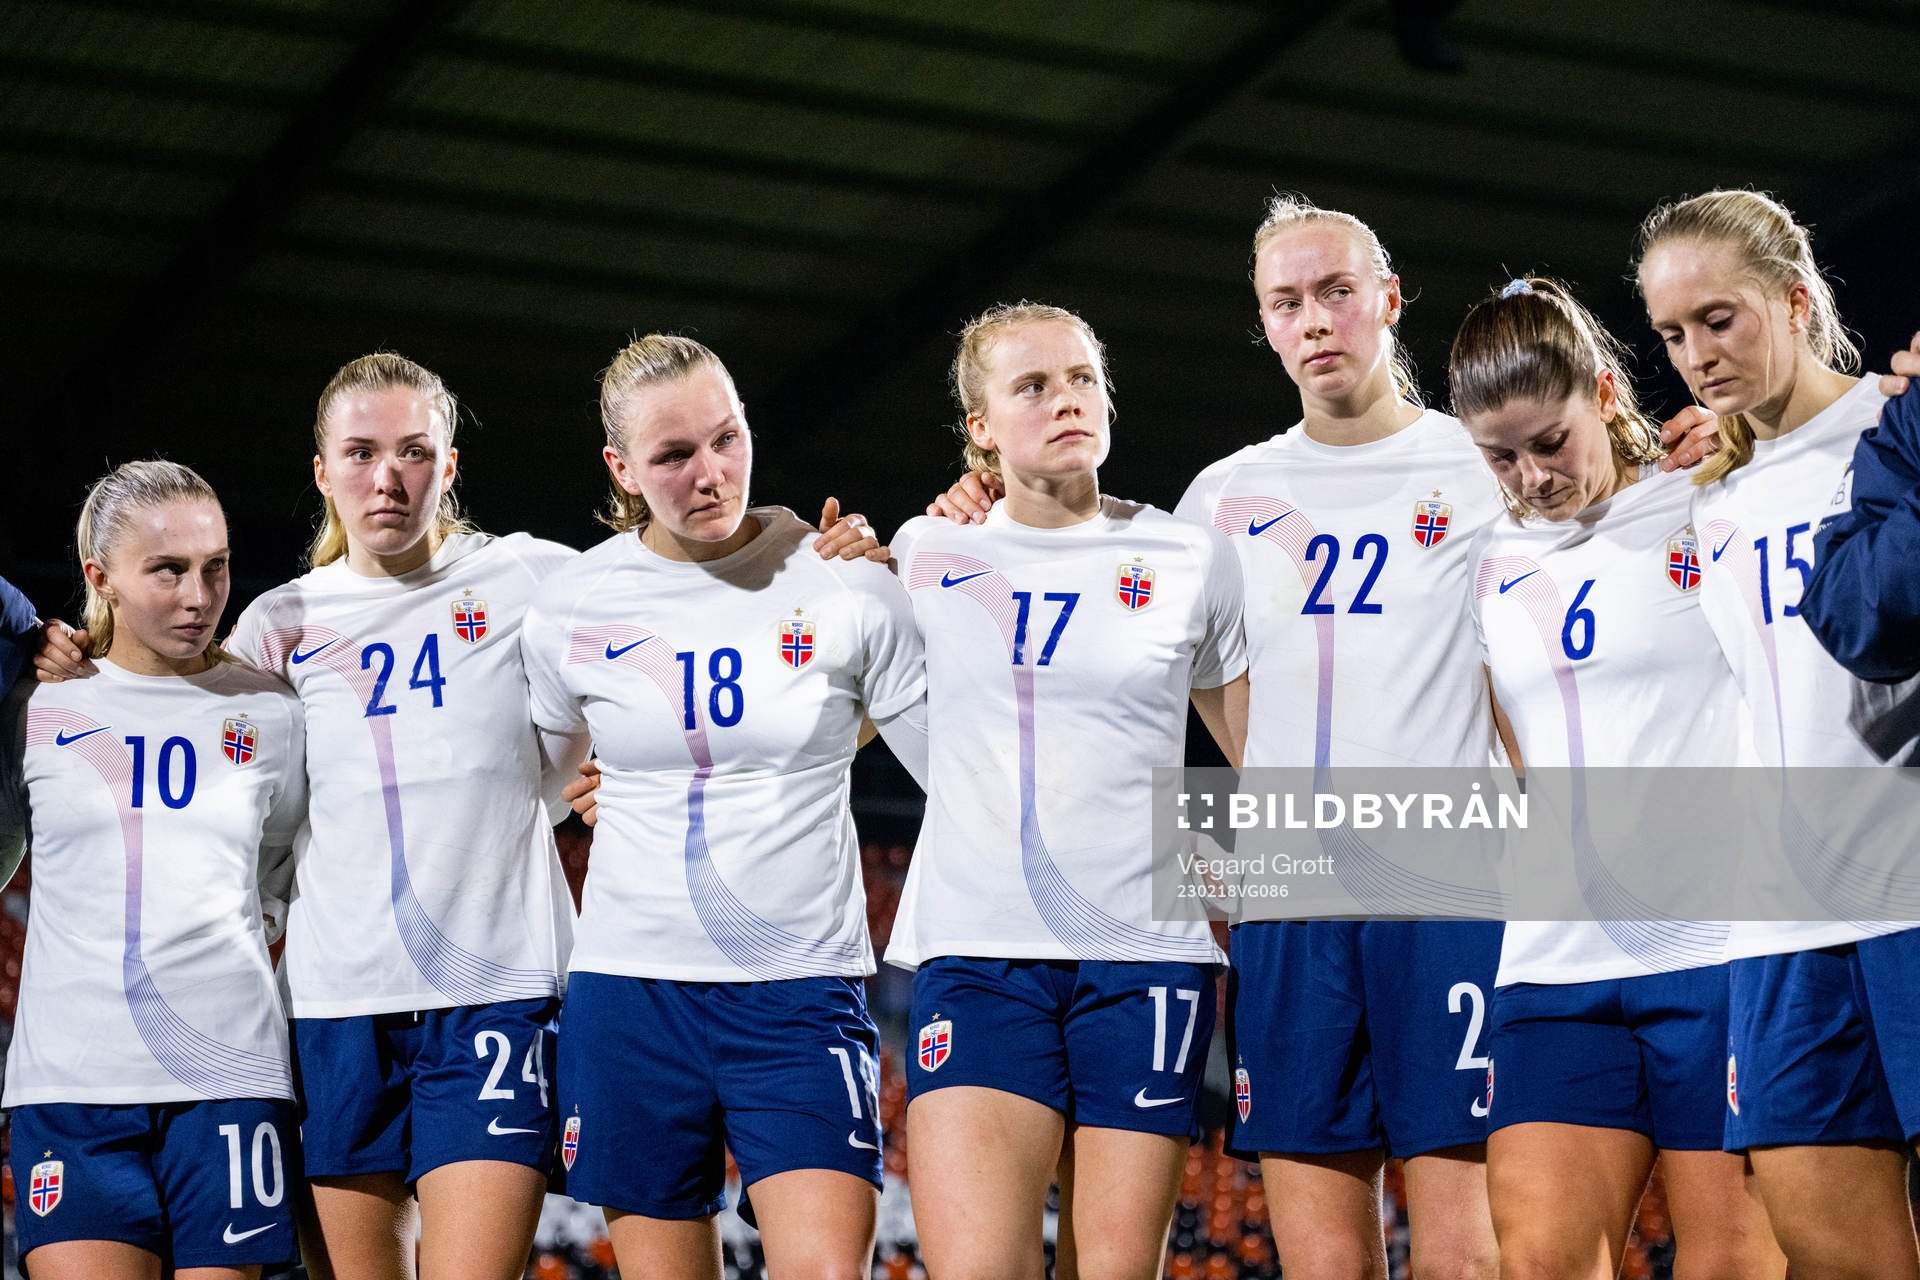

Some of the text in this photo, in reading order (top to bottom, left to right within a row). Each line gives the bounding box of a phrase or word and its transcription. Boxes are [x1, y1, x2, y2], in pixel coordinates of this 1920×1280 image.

[1302, 534, 1389, 615] 22
[1754, 521, 1813, 625] 15
[1013, 592, 1081, 666] 17
[1562, 579, 1595, 661] 6
[361, 633, 446, 717] 24
[676, 648, 744, 730] 18
[125, 736, 197, 809] 10
[474, 1028, 549, 1108] 24
[1148, 987, 1200, 1074] 17
[219, 1121, 284, 1209] 10
